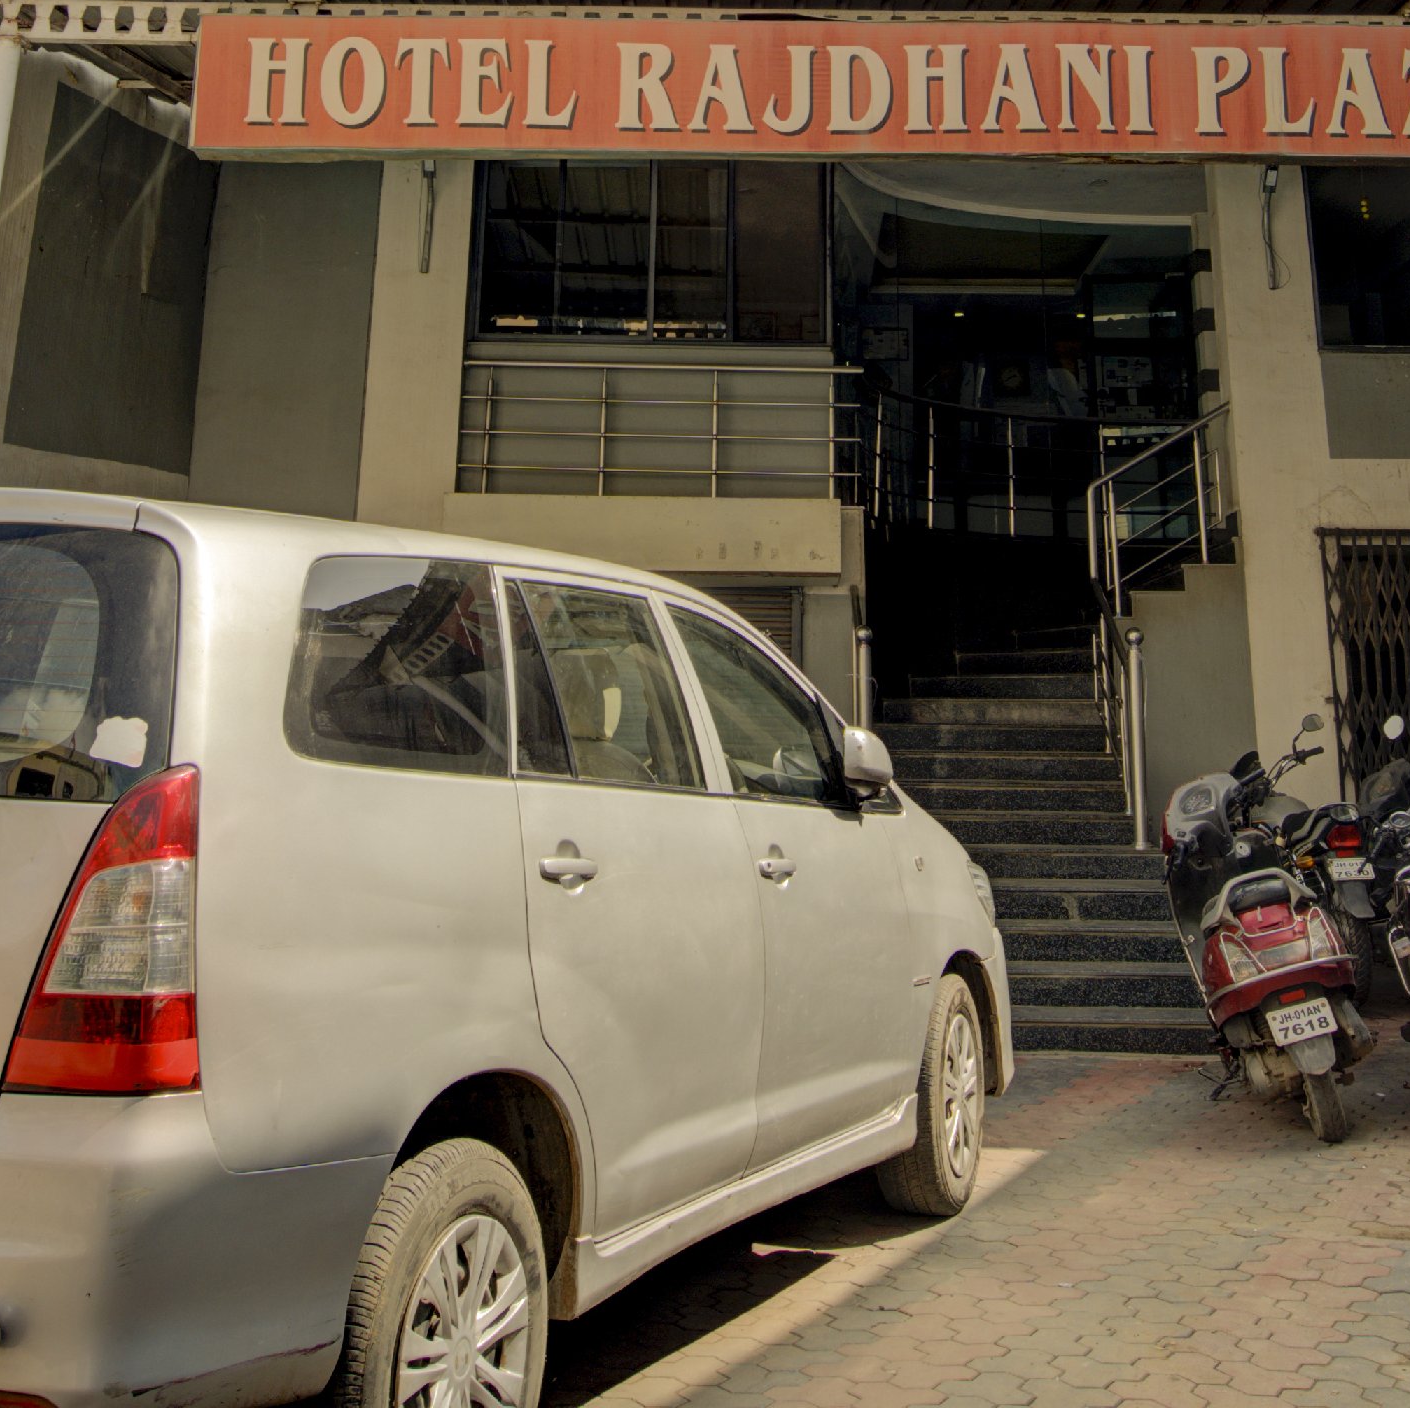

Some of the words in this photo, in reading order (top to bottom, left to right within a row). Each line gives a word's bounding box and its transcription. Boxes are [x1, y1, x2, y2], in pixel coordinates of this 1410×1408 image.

[244, 36, 579, 130] HOTEL
[614, 42, 1158, 136] RAJDHANI
[1278, 1016, 1330, 1040] 7618
